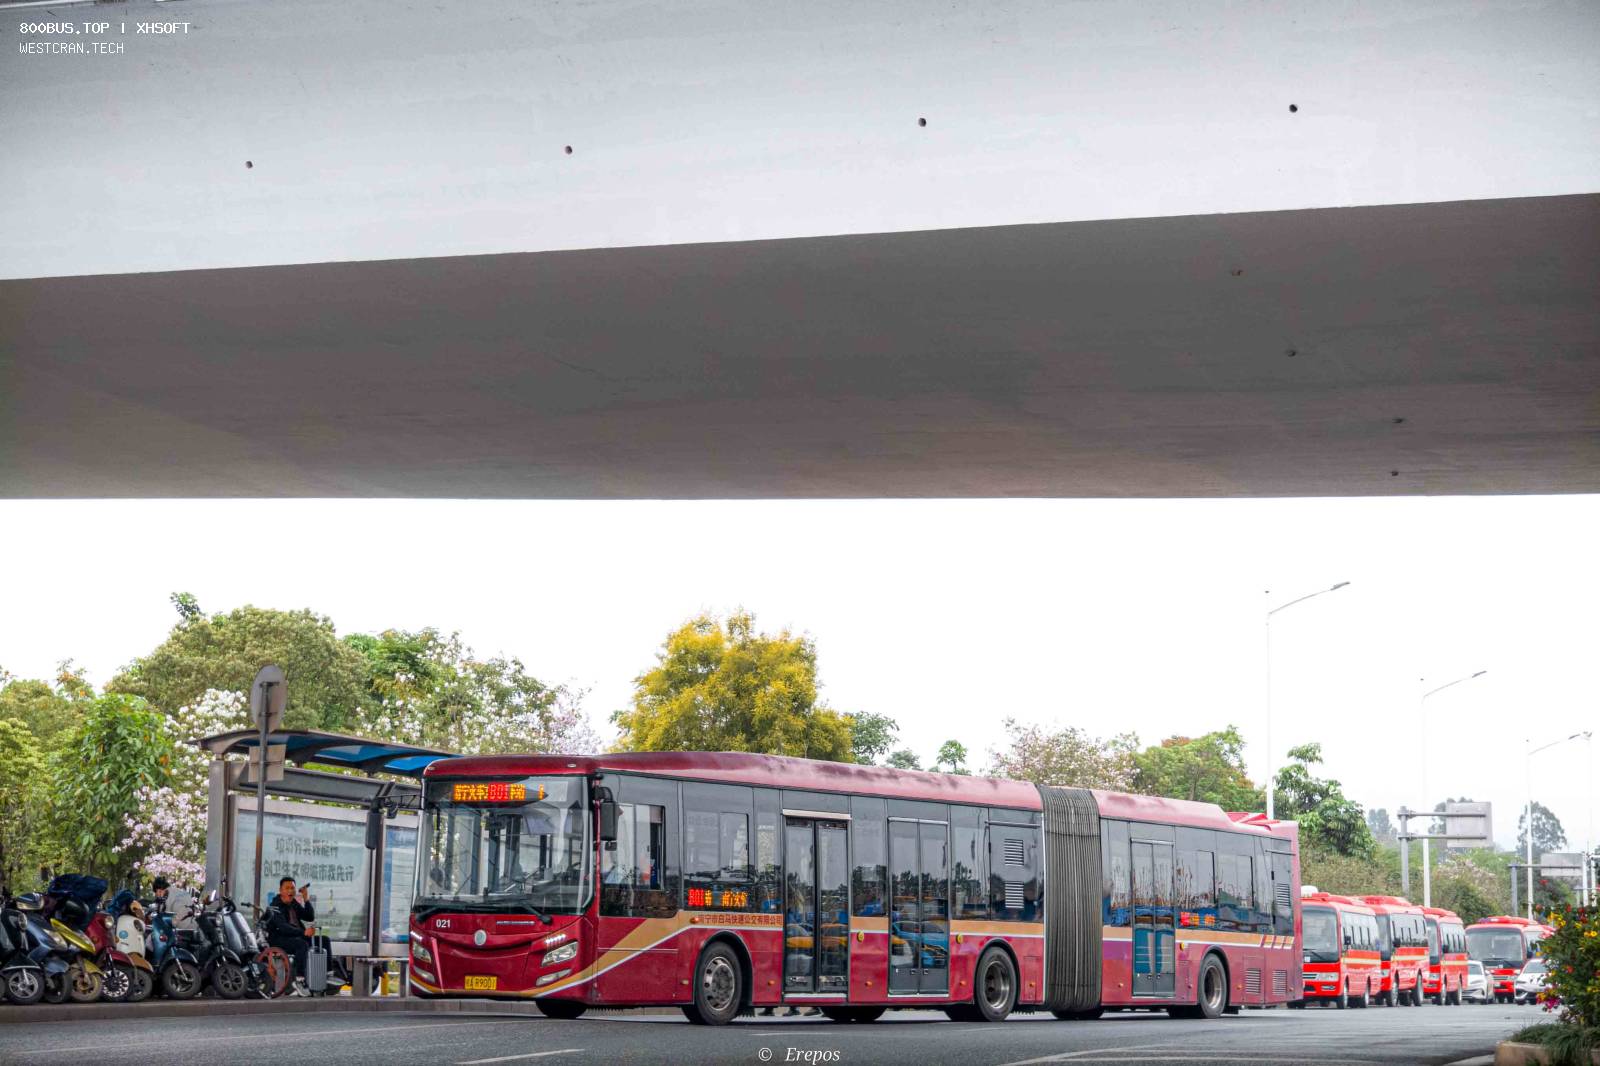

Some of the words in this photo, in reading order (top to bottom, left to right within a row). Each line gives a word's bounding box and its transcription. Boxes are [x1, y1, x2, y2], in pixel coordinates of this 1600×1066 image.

[253, 859, 355, 882] 创卫生文明城市我先行
[435, 918, 451, 928] 021
